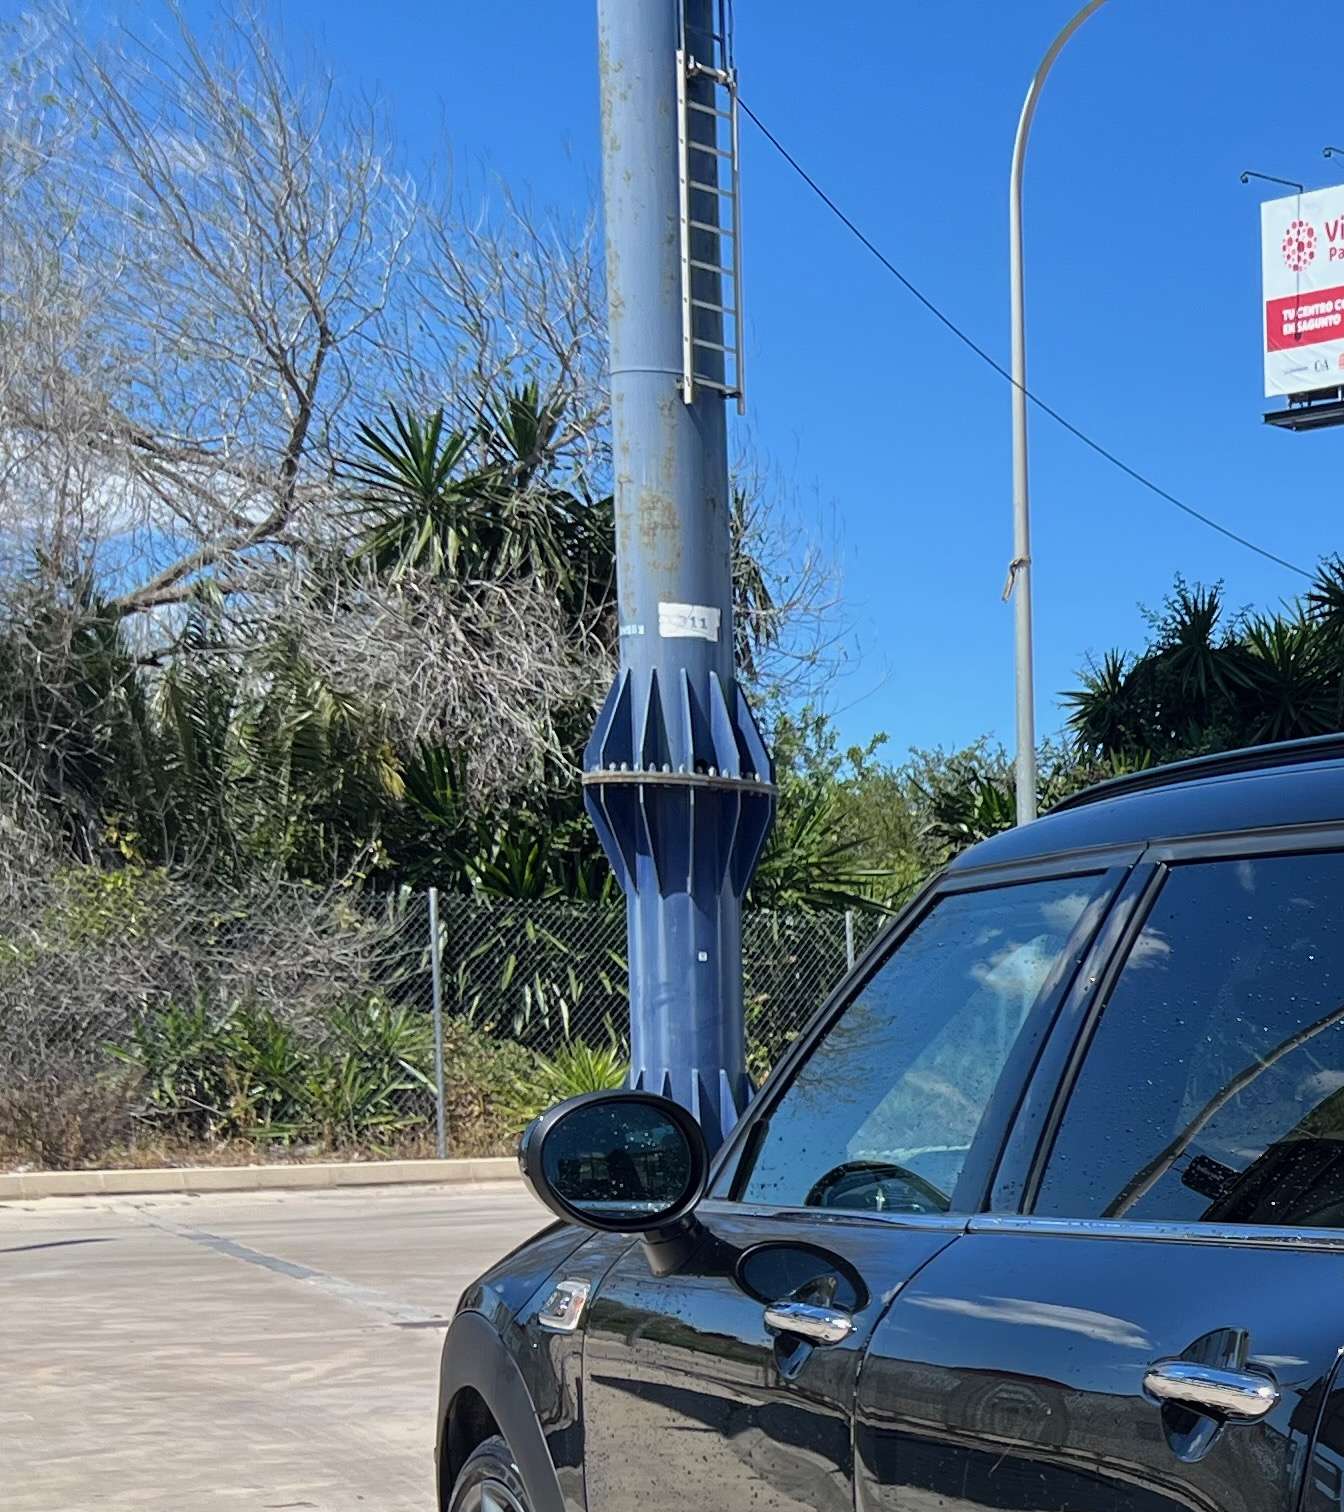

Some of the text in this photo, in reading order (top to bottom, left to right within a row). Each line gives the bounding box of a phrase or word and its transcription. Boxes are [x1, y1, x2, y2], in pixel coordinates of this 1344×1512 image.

[1282, 308, 1296, 321] TU
[1296, 300, 1333, 319] CENTRO
[1282, 314, 1342, 336] EN SAGUNTO
